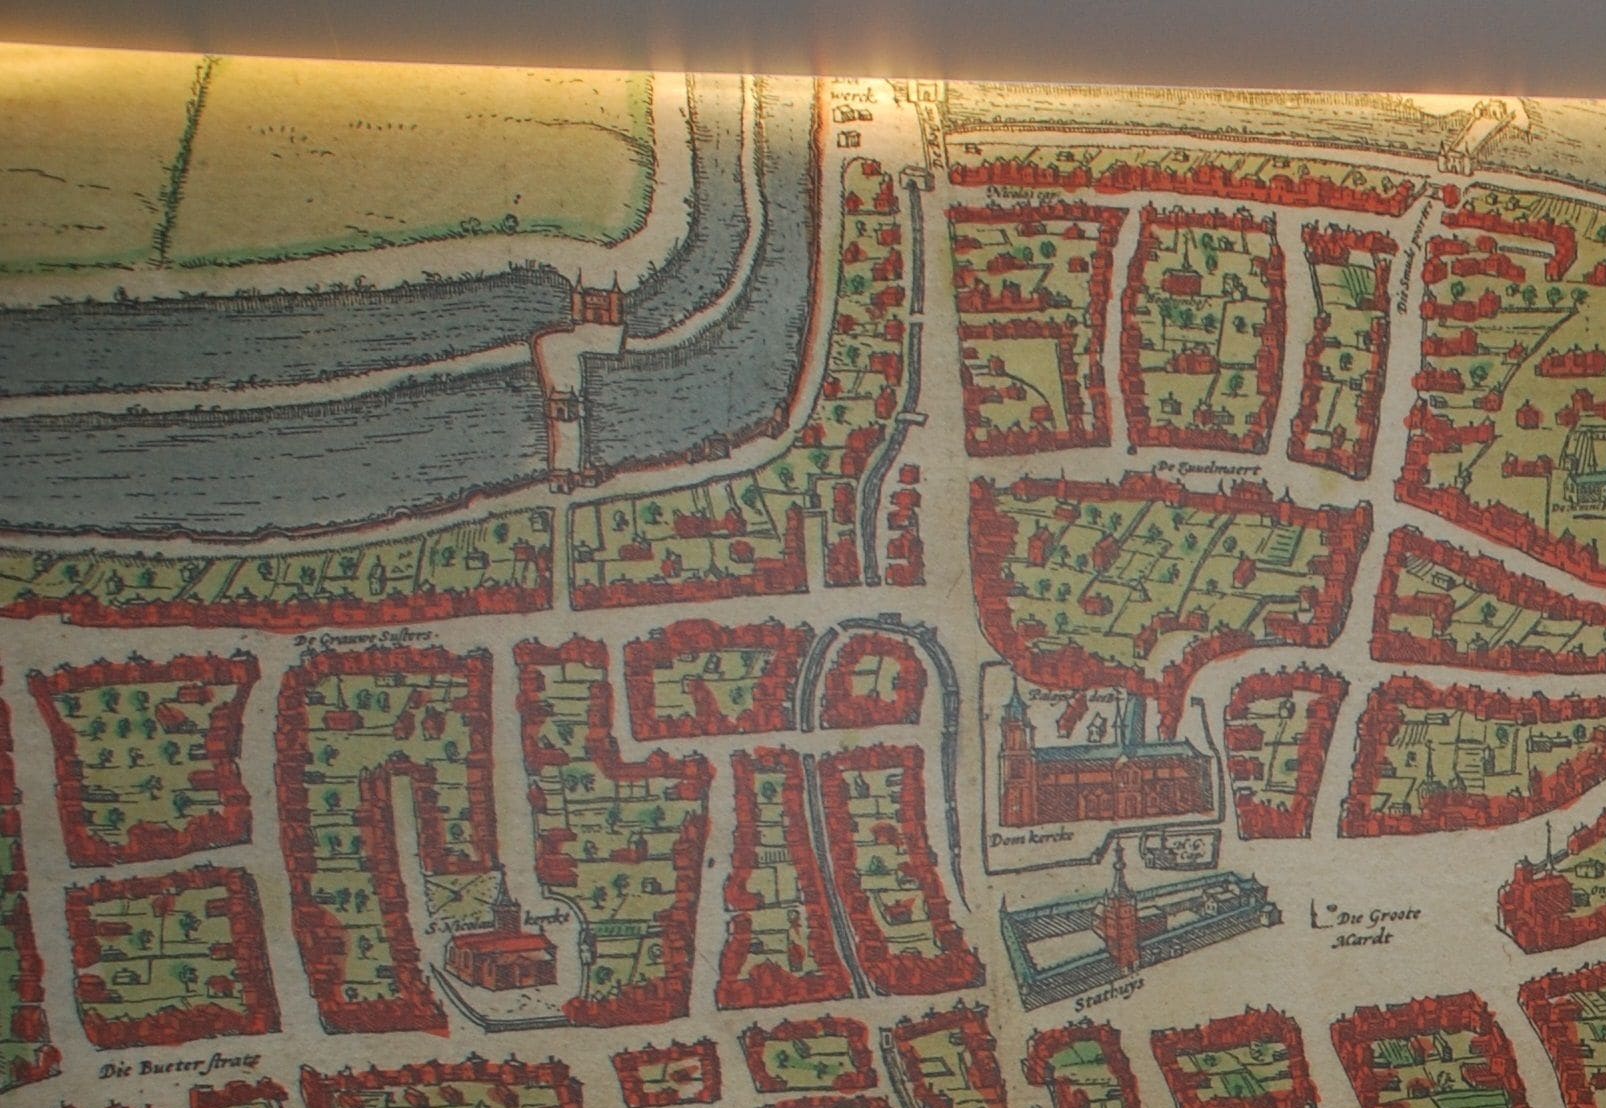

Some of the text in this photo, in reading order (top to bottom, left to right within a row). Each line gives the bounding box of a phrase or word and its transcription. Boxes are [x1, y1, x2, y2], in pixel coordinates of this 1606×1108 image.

[1337, 907, 1421, 929] Die Groote
[99, 1061, 133, 1079] Die
